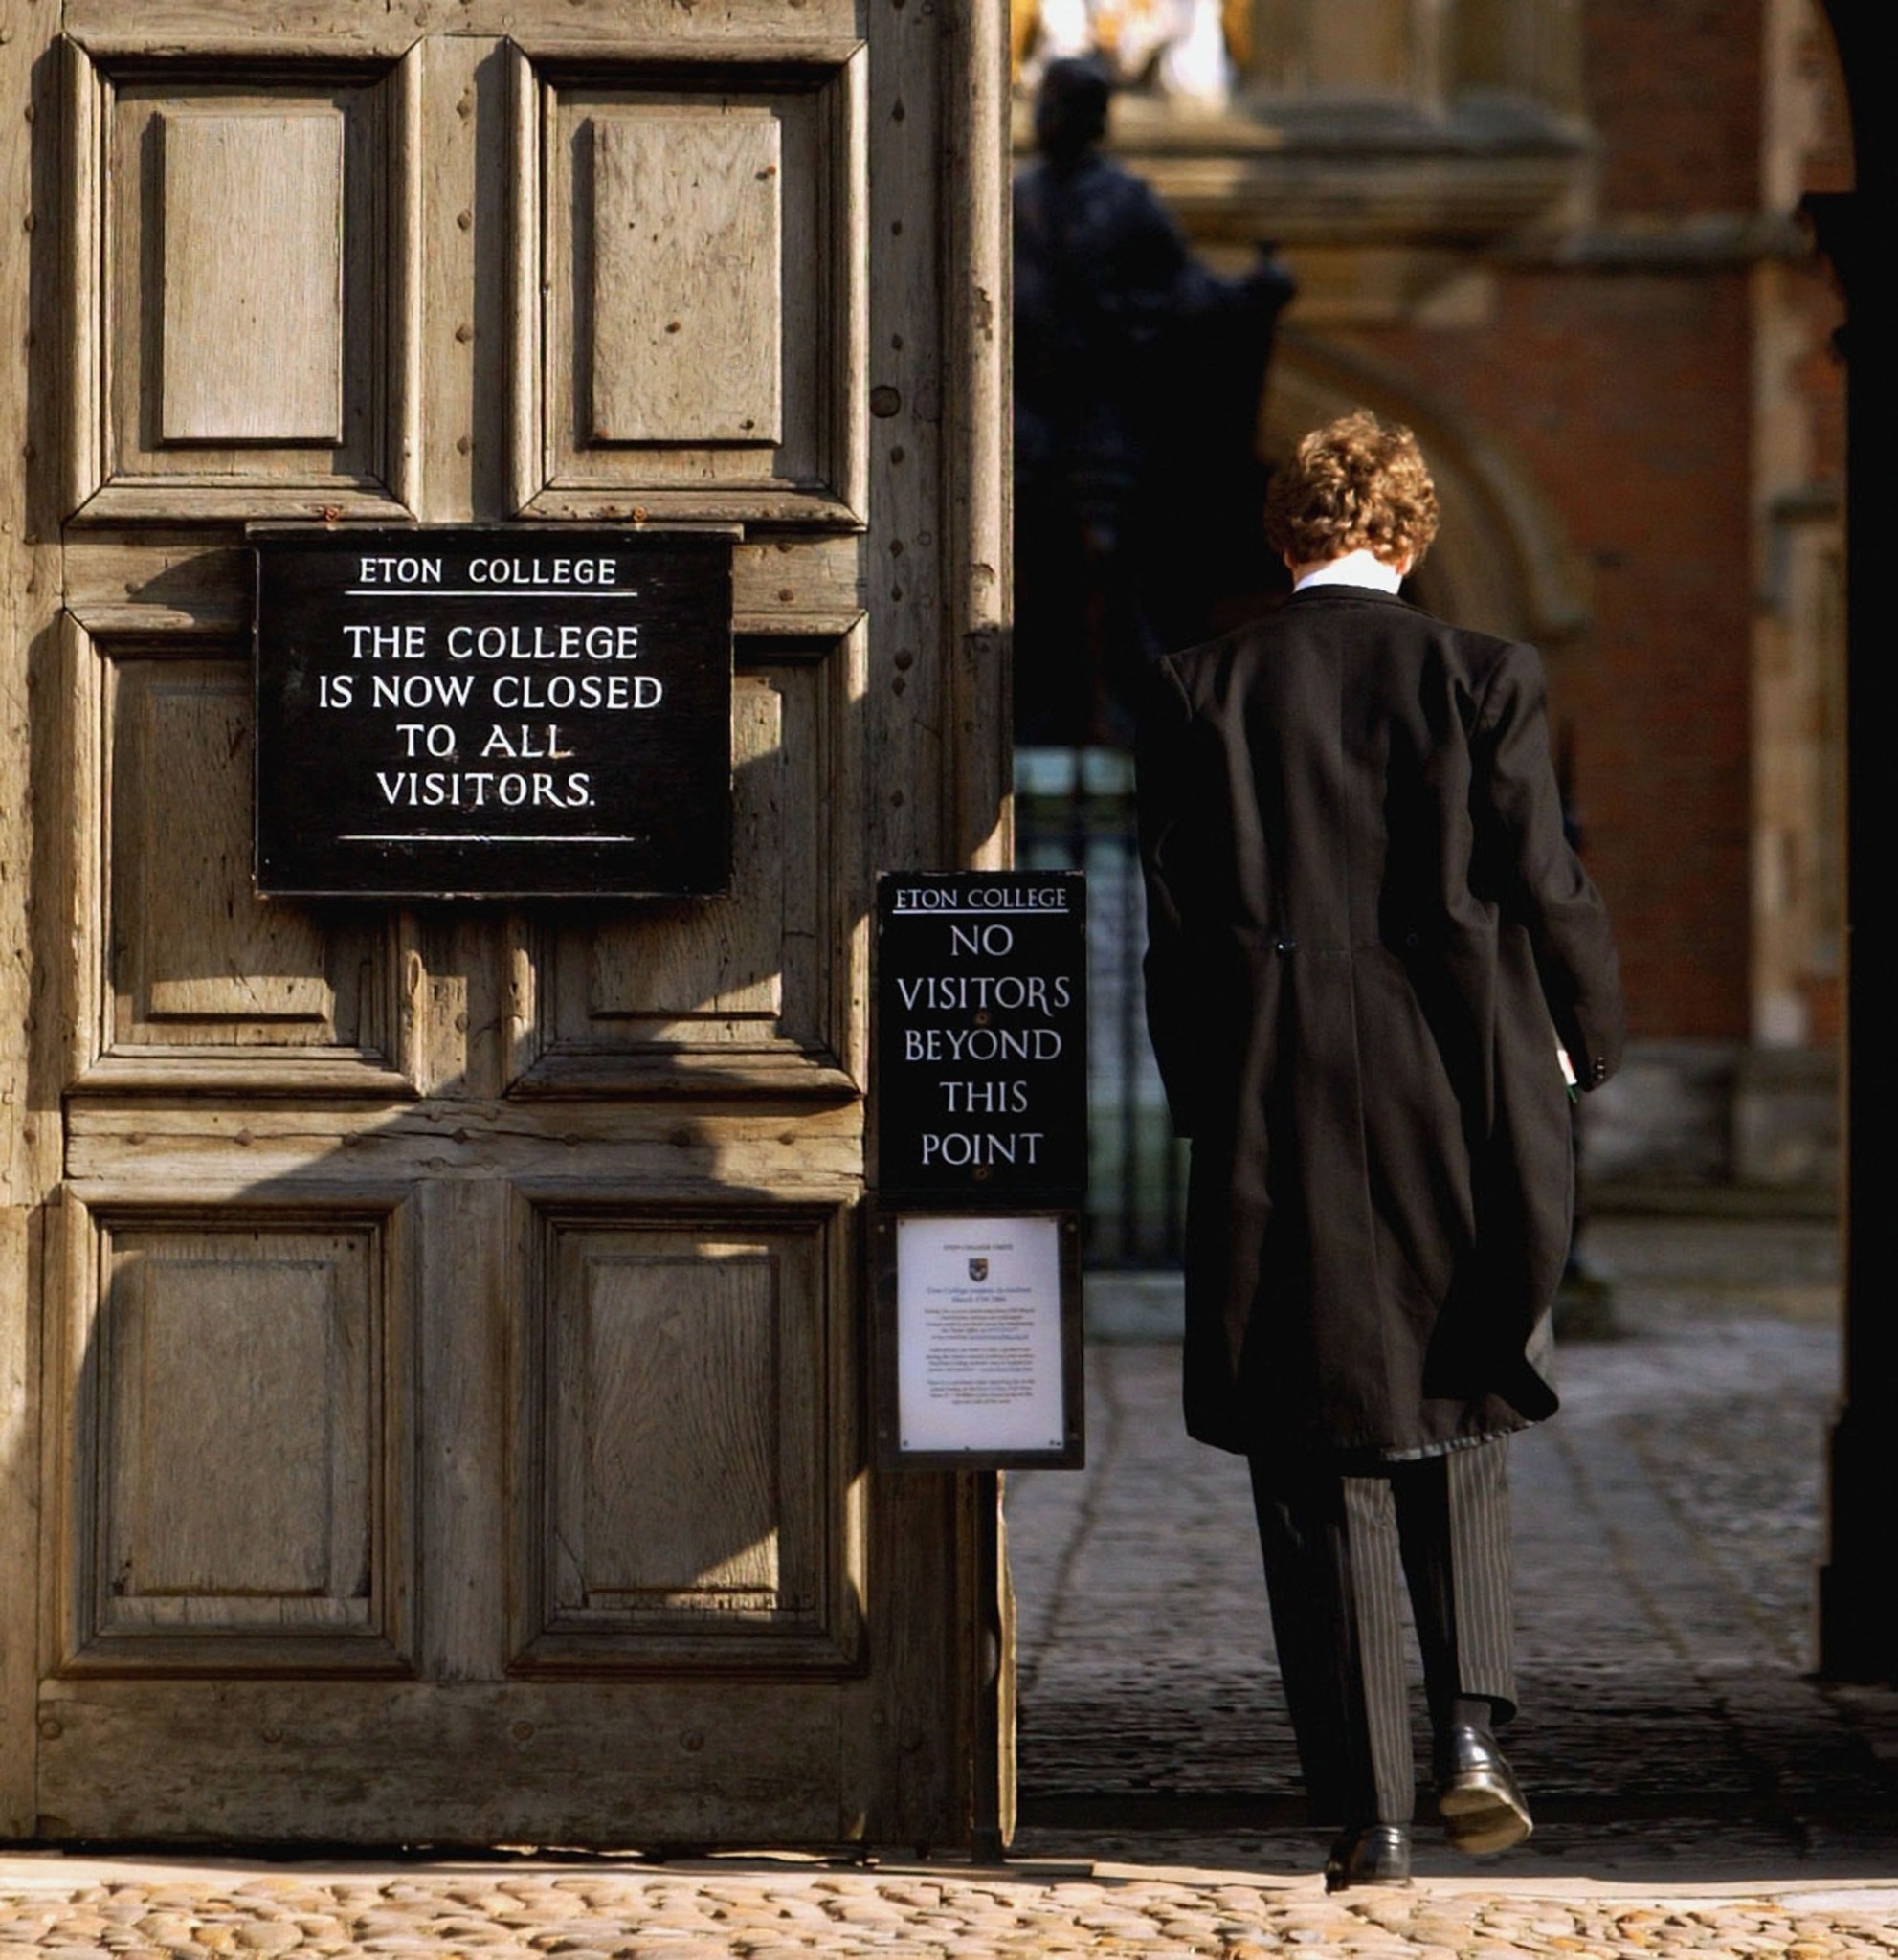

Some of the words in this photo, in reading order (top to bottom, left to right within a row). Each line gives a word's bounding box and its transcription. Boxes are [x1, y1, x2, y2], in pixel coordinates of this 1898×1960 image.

[359, 557, 442, 584] ETON
[468, 558, 617, 585] COLLEGE
[342, 625, 426, 658] THE
[447, 625, 639, 660] COLLEGE
[319, 674, 354, 709] IS
[372, 675, 476, 708] NOW
[492, 675, 663, 710] CLOSED
[395, 724, 458, 758] TO
[480, 724, 574, 759] ALL
[376, 771, 596, 808] VISITORS.
[896, 889, 957, 908] ETON
[968, 888, 1065, 907] COLLEGE
[950, 924, 1013, 956] NO
[897, 976, 1070, 1017] VISITORS
[905, 1029, 1061, 1061] BEYOND
[939, 1080, 1027, 1112] THIS
[923, 1133, 1043, 1165] POINT
